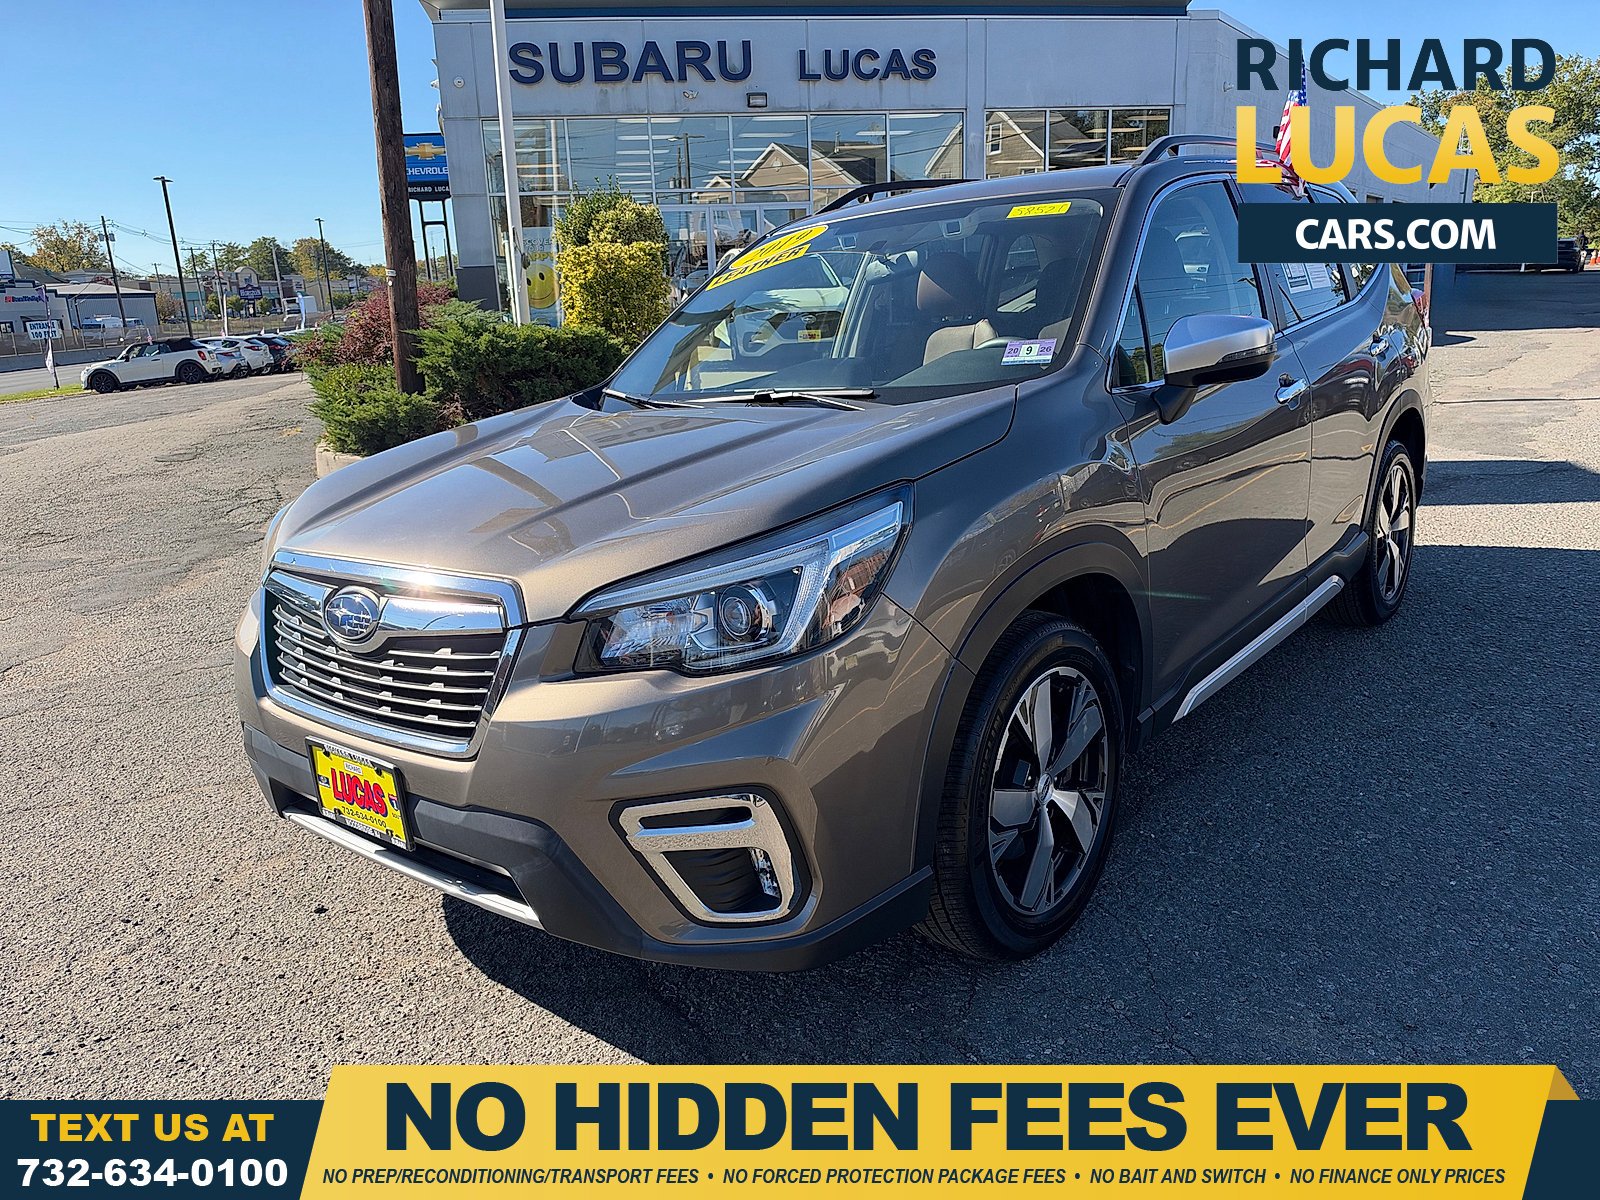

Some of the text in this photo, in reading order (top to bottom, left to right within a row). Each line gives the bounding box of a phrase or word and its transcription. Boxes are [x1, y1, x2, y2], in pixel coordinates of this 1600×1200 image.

[509, 40, 752, 85] SUBARU
[798, 48, 937, 82] LUCAS
[1025, 345, 1033, 355] 9
[1039, 345, 1052, 353] 26
[331, 767, 388, 818] LUCAS
[341, 806, 387, 828] 732-634-0100
